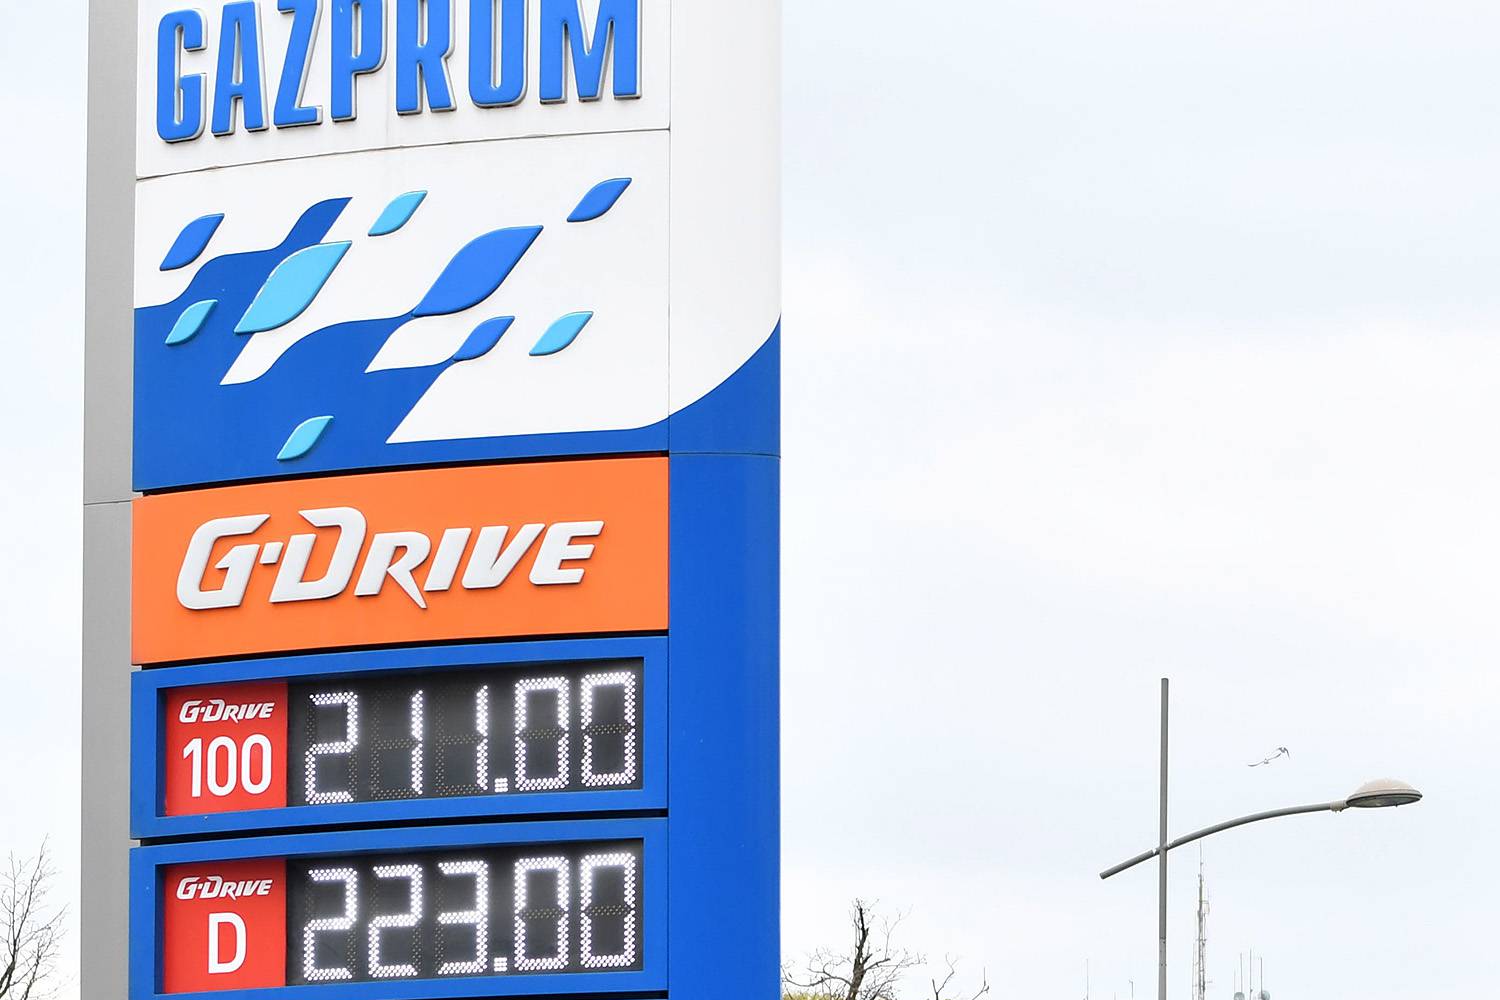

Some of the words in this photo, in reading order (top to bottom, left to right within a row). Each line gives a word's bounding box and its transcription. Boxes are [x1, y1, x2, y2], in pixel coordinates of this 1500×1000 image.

[156, 0, 643, 144] GAZPROM
[182, 734, 272, 798] 100
[304, 671, 636, 804] 211.00
[206, 912, 247, 976] D
[302, 853, 637, 981] 223.00
